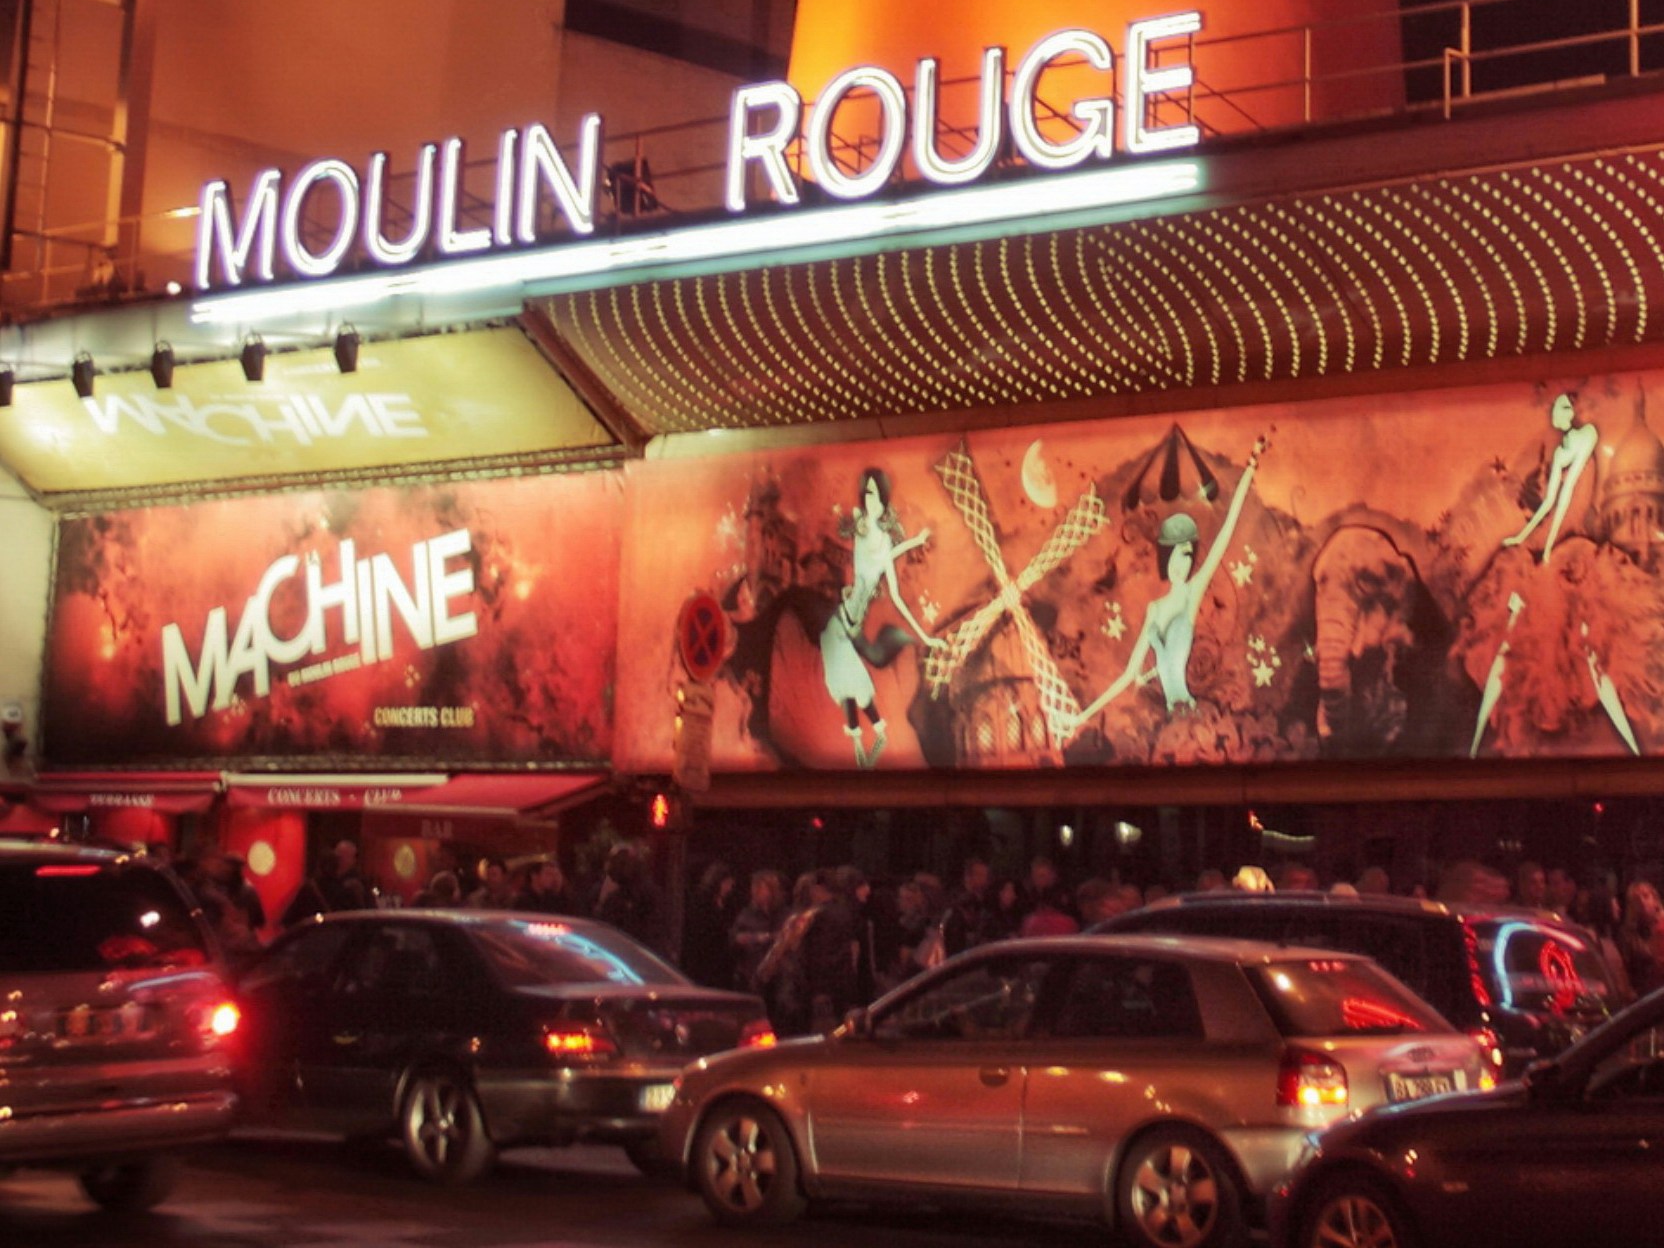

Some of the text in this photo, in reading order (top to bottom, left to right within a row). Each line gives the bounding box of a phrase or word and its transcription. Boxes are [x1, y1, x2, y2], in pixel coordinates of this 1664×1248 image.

[195, 11, 1203, 290] MOULIN ROUGE
[162, 528, 478, 727] MACHINE
[374, 707, 474, 728] CONCERTS CLUB
